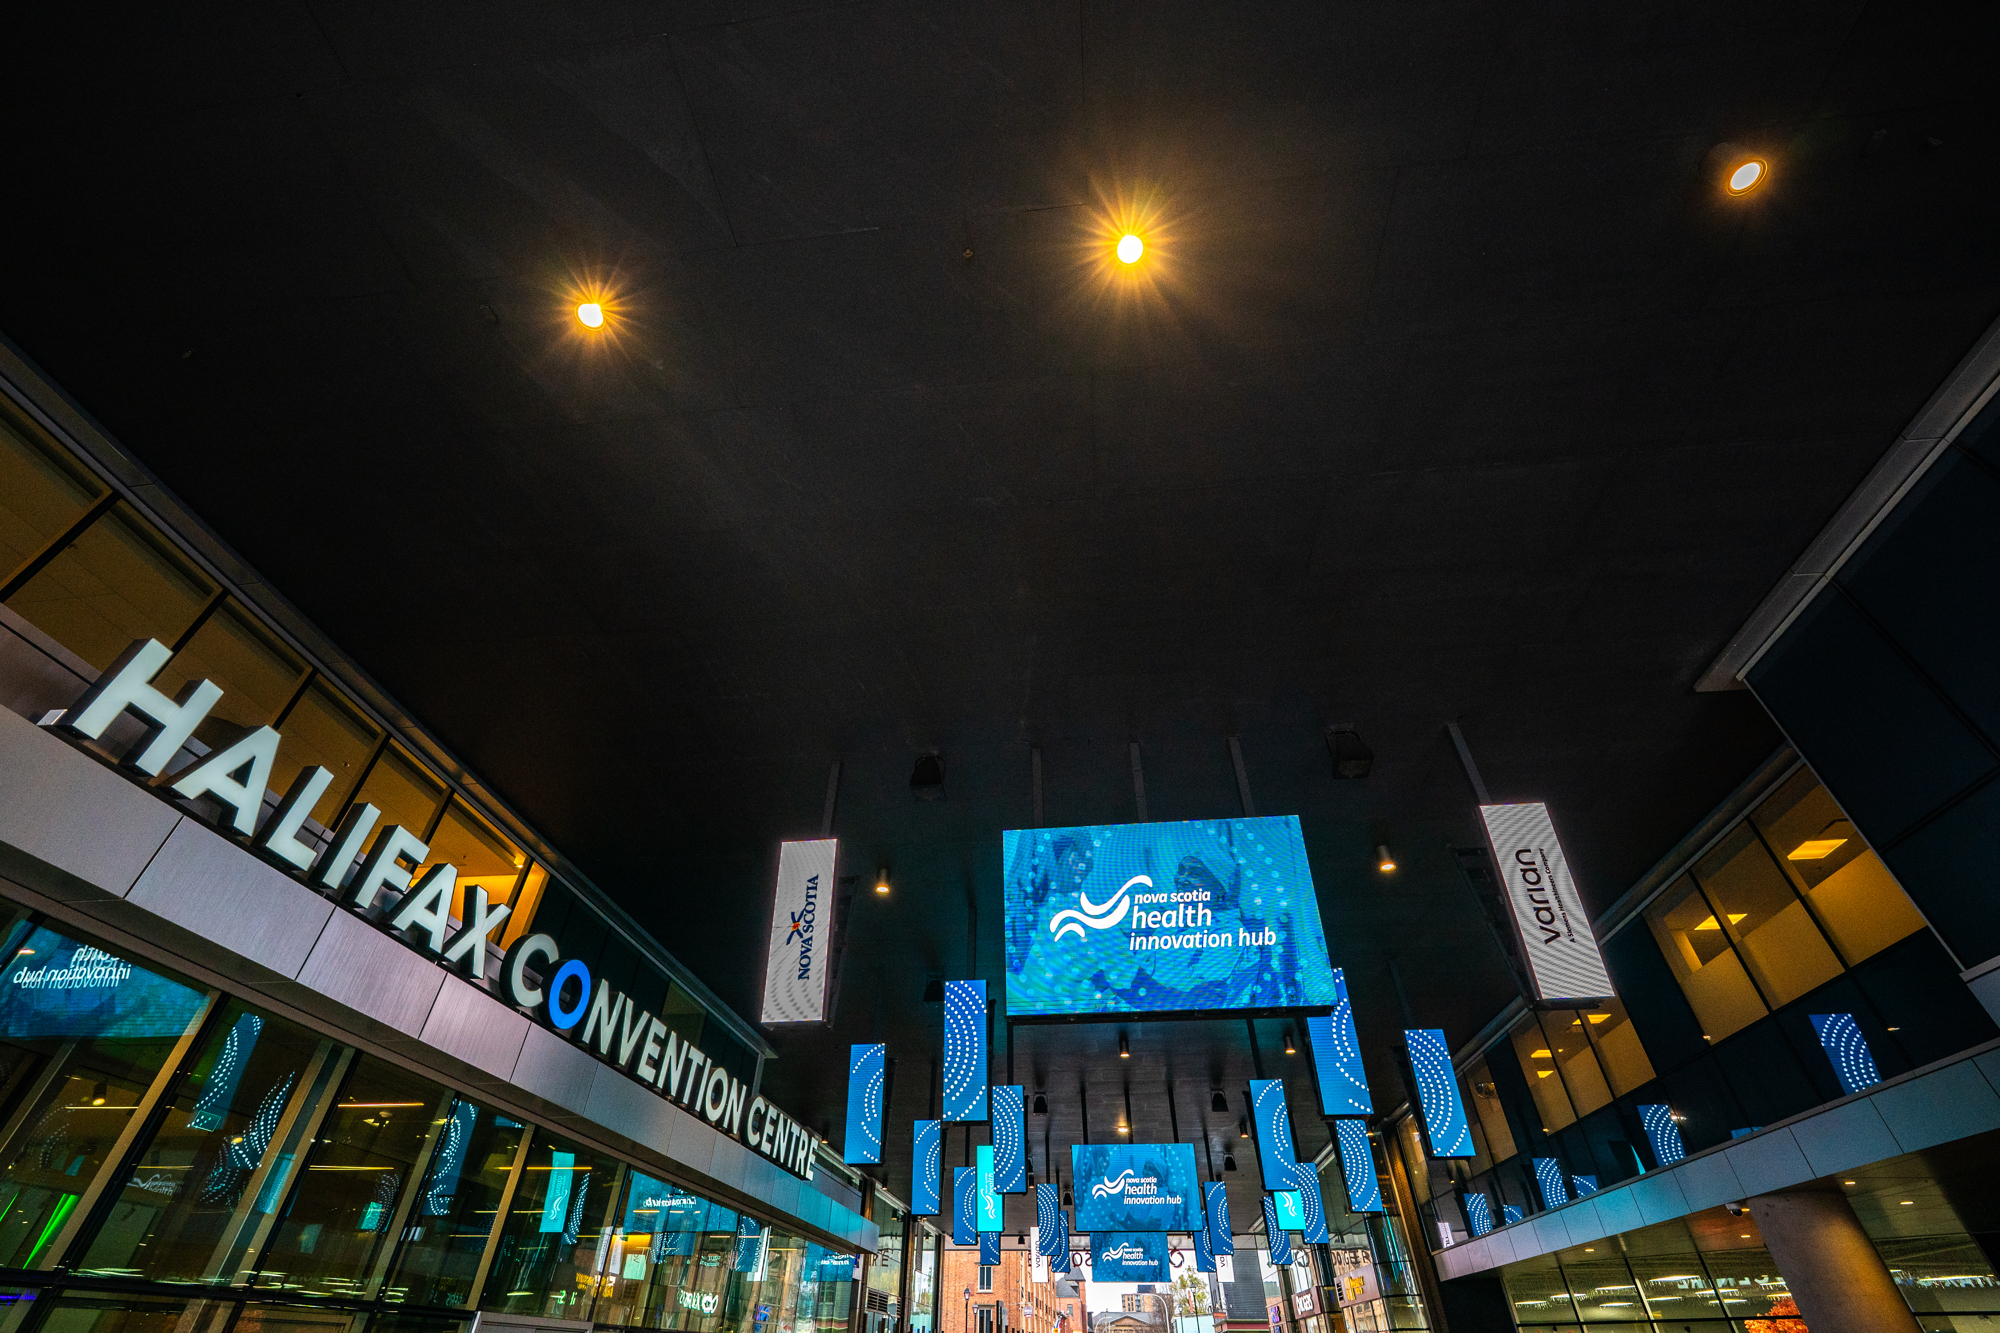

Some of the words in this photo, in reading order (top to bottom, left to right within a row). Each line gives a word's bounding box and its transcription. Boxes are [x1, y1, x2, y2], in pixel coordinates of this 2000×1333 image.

[1538, 848, 1551, 874] Company
[802, 873, 819, 934] SCOTIA
[1133, 892, 1168, 904] nova
[1170, 888, 1211, 904] scotia
[1514, 848, 1561, 945] varian
[68, 638, 511, 979] HALIFAX
[506, 932, 747, 1137] CONVENTION
[747, 1096, 819, 1181] CENTRE
[1131, 903, 1212, 929] health
[1561, 912, 1574, 937] Siemens
[1129, 930, 1232, 951] innovation
[1238, 927, 1277, 947] hub
[797, 934, 814, 981] NOVA
[1123, 1196, 1165, 1205] innovation
[1166, 1195, 1182, 1204] hub
[1124, 1183, 1158, 1195] health
[1122, 1252, 1144, 1260] health
